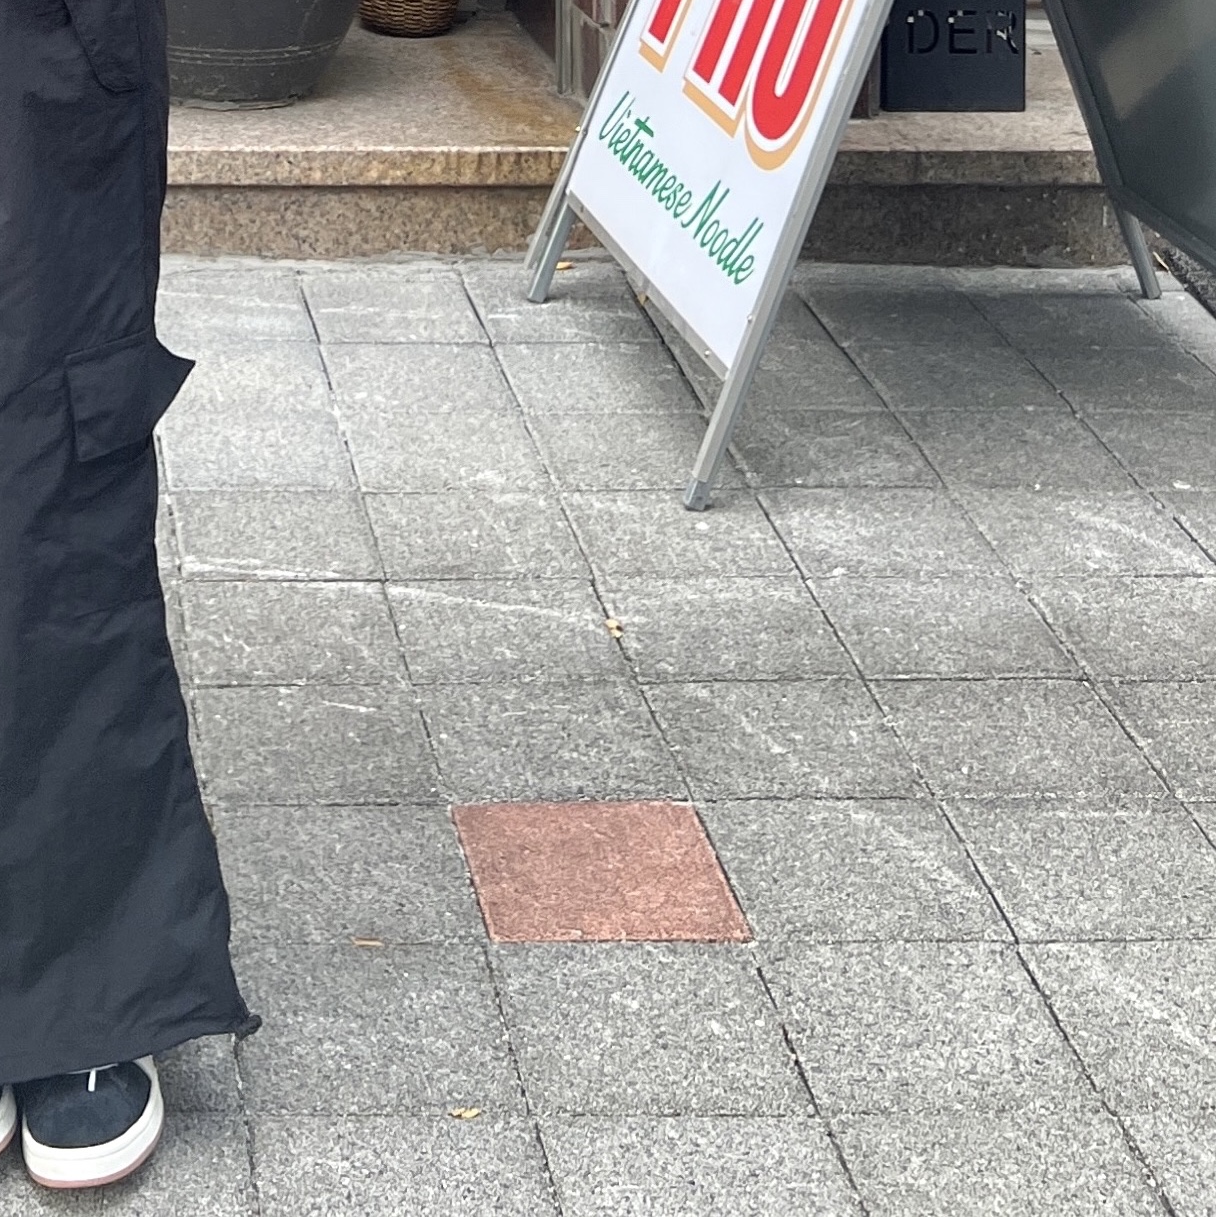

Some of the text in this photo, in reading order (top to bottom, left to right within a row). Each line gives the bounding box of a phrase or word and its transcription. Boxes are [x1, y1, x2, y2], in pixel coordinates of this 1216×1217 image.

[906, 9, 1020, 55] DER
[599, 90, 765, 285] Vietnamese Noodle
